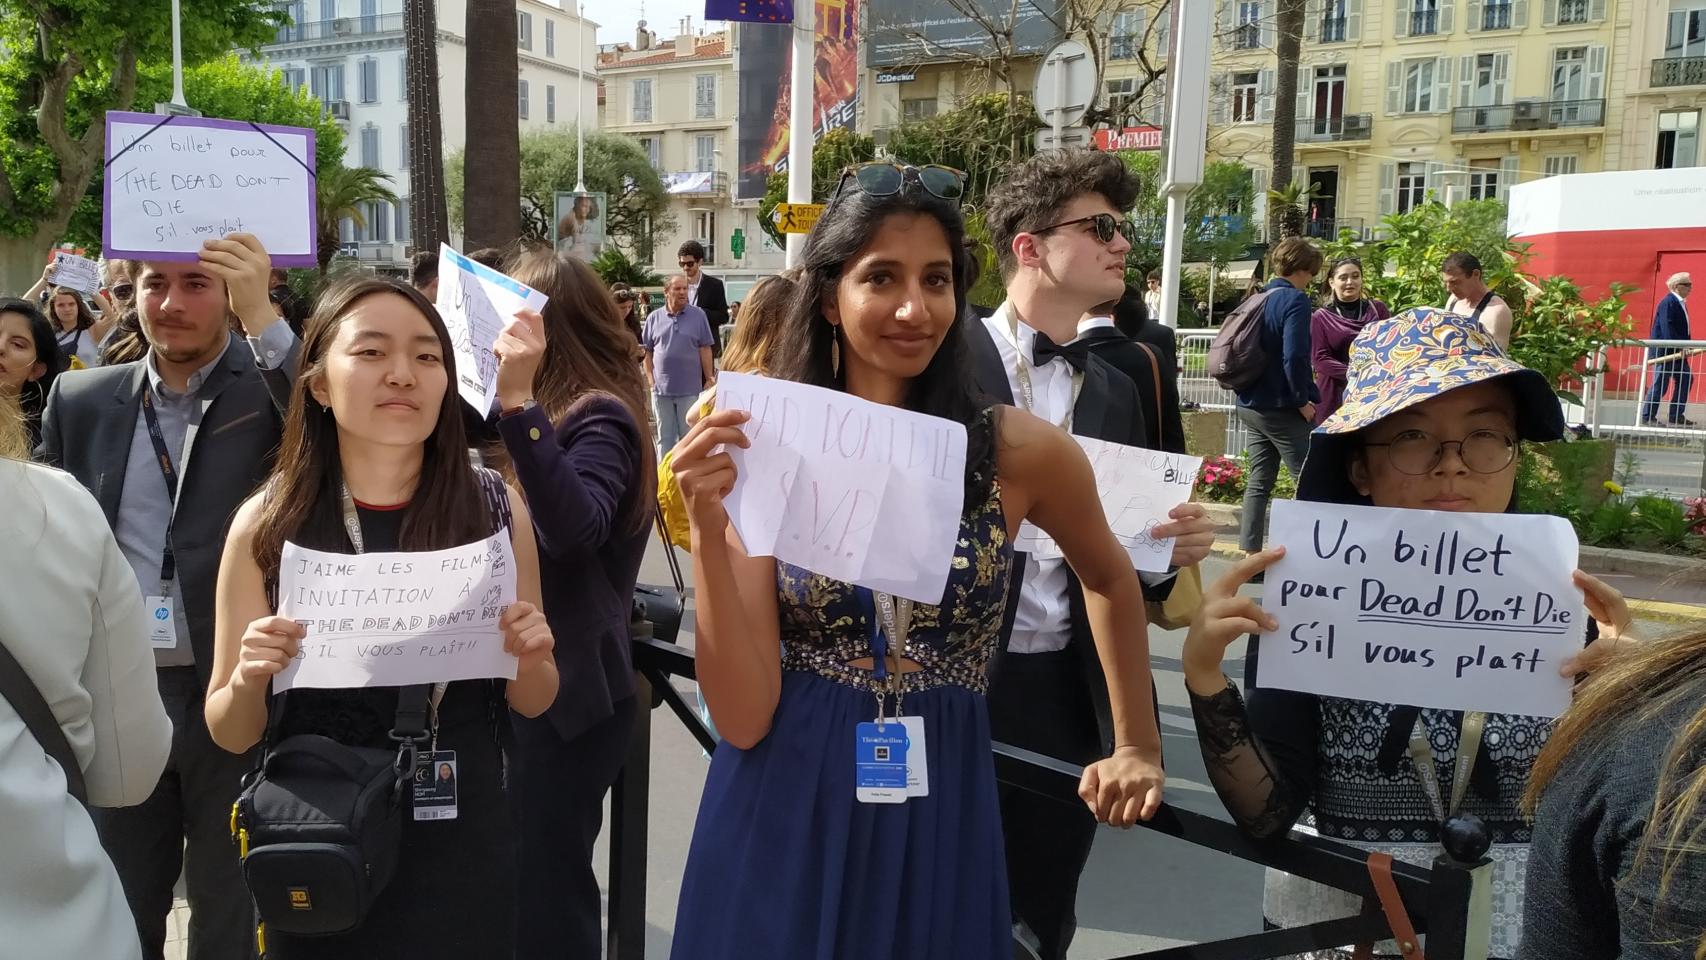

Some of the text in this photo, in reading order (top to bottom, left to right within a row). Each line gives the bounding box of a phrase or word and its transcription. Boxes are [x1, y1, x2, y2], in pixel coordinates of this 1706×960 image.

[876, 74, 915, 84] JCDecaux
[169, 135, 213, 153] billet
[115, 167, 161, 195] THE
[171, 173, 223, 191] DEAD
[142, 199, 185, 217] DIE
[191, 224, 214, 235] vous
[1163, 469, 1196, 485] BILLE
[1313, 518, 1513, 577] Un billet
[297, 559, 358, 577] J'AIME
[377, 562, 414, 575] LES
[297, 585, 435, 607] INVITATION
[1281, 578, 1572, 624] pour Dead Don't Die
[294, 618, 355, 633] THE
[362, 615, 423, 631] DEAD
[427, 609, 476, 629] DON'T
[357, 644, 406, 658] VOUS
[1364, 641, 1436, 668] vous
[1455, 644, 1546, 679] plaît
